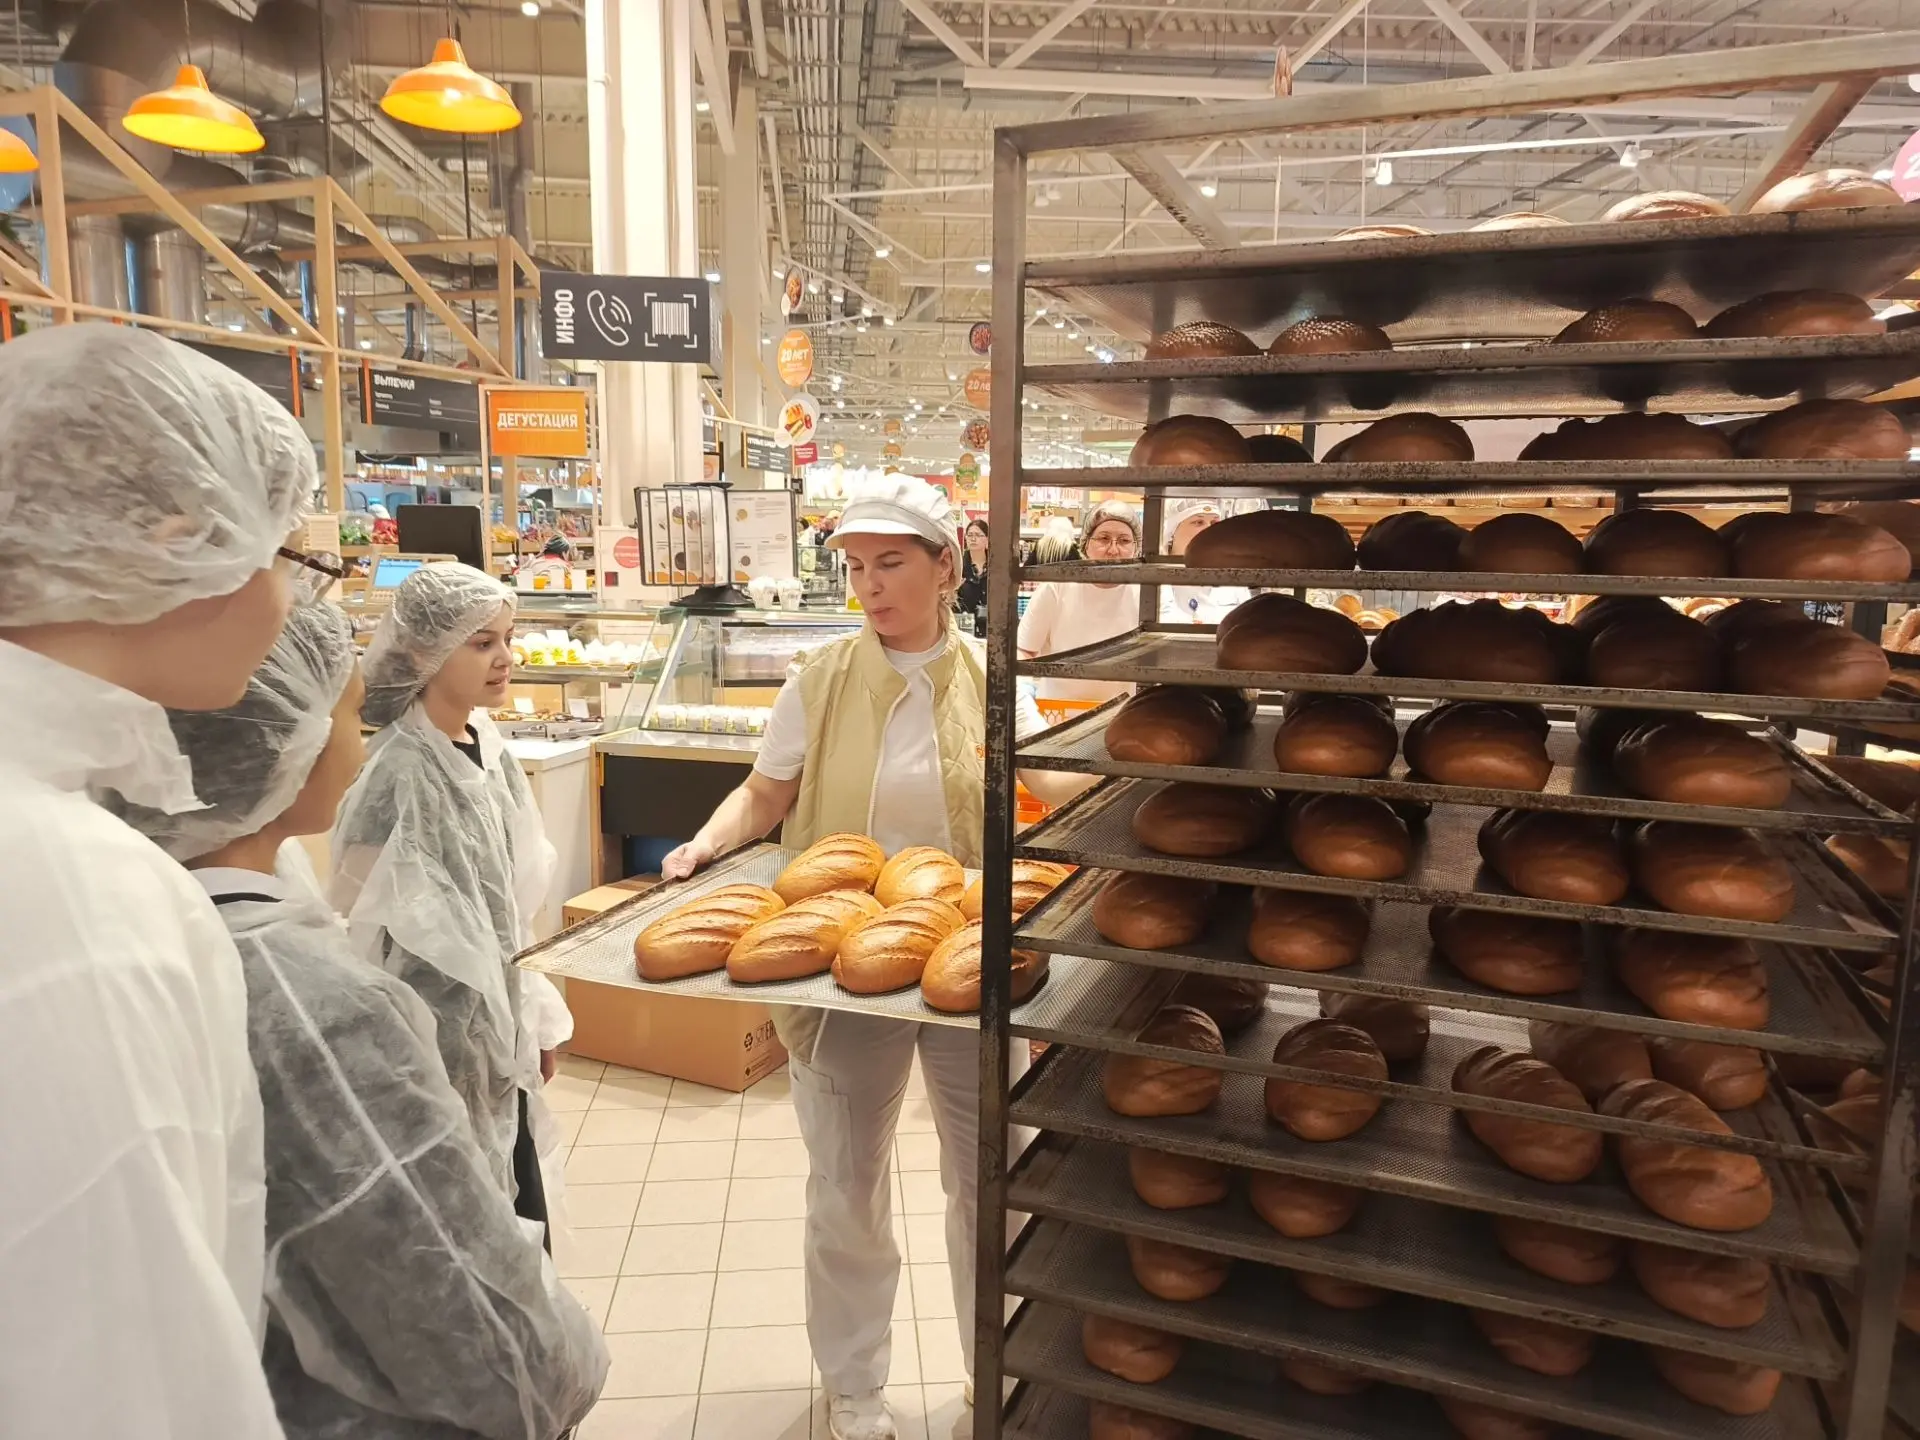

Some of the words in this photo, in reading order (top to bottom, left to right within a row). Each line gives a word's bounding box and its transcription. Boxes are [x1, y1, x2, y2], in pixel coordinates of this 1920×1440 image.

[554, 288, 575, 344] ИНФО
[373, 374, 415, 390] ВЫПЕЧКА
[497, 412, 578, 428] ДЕГУСТАЦИЯ
